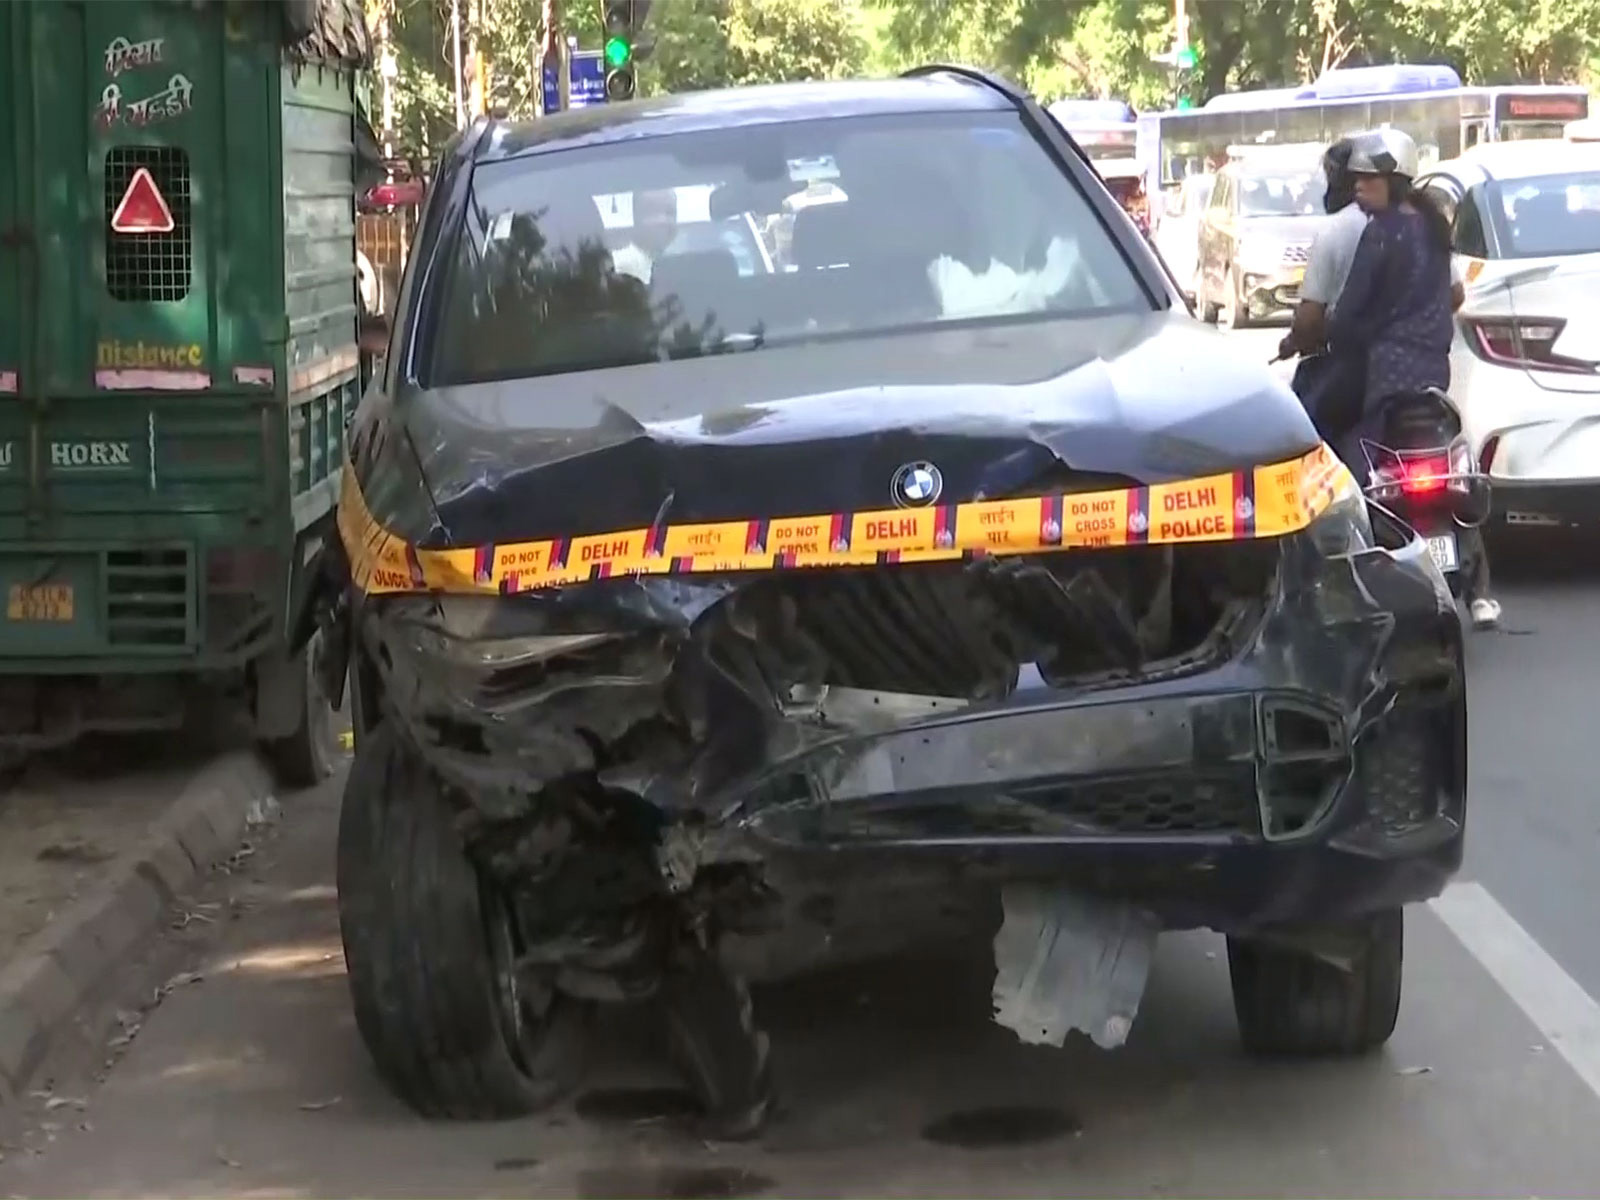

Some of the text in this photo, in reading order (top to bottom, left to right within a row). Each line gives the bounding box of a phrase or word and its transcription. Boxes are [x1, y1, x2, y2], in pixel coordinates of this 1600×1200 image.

[51, 442, 130, 466] HORN
[1071, 500, 1116, 515] DO NOT
[1163, 486, 1216, 512] DELHI
[776, 525, 820, 539] DO NOT
[866, 517, 917, 540] DELHI
[1075, 518, 1116, 533] CROSS
[1160, 514, 1226, 540] POLICE
[501, 550, 541, 566] DO NOT
[581, 540, 629, 562] DELHI
